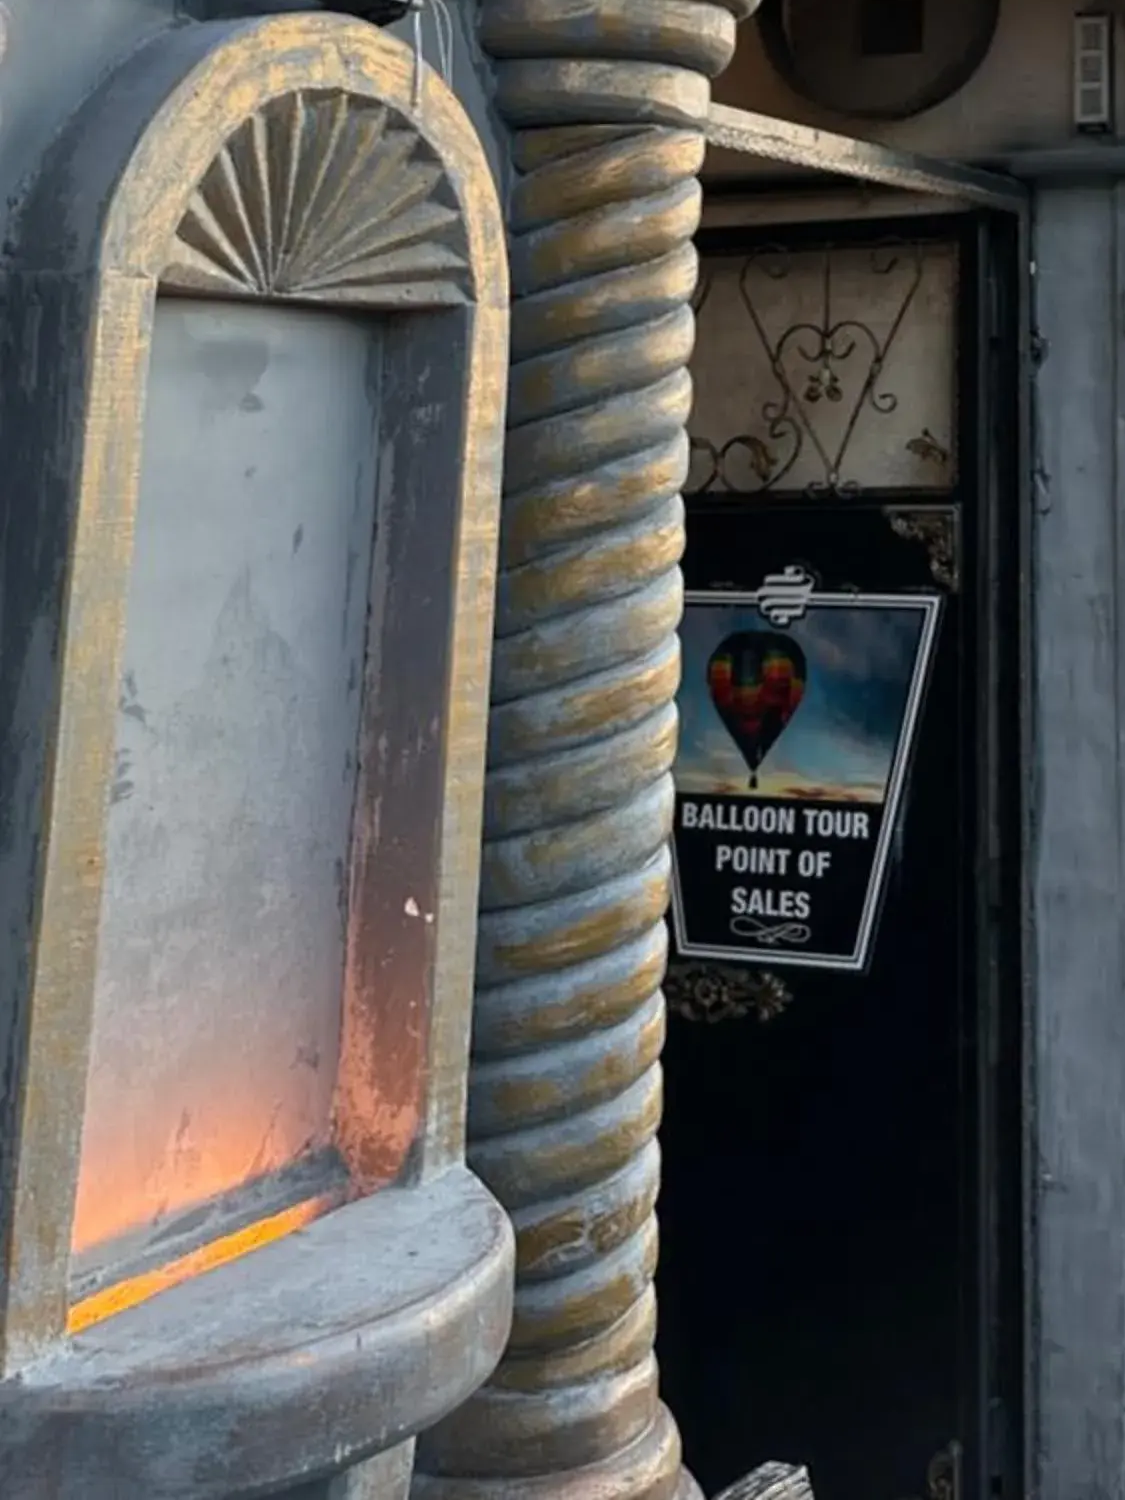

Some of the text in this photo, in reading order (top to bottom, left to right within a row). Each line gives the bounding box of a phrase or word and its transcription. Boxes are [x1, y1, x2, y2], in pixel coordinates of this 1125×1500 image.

[681, 801, 870, 840] BALLOON TOUR
[715, 844, 832, 879] POINT OF
[730, 885, 812, 919] SALES
